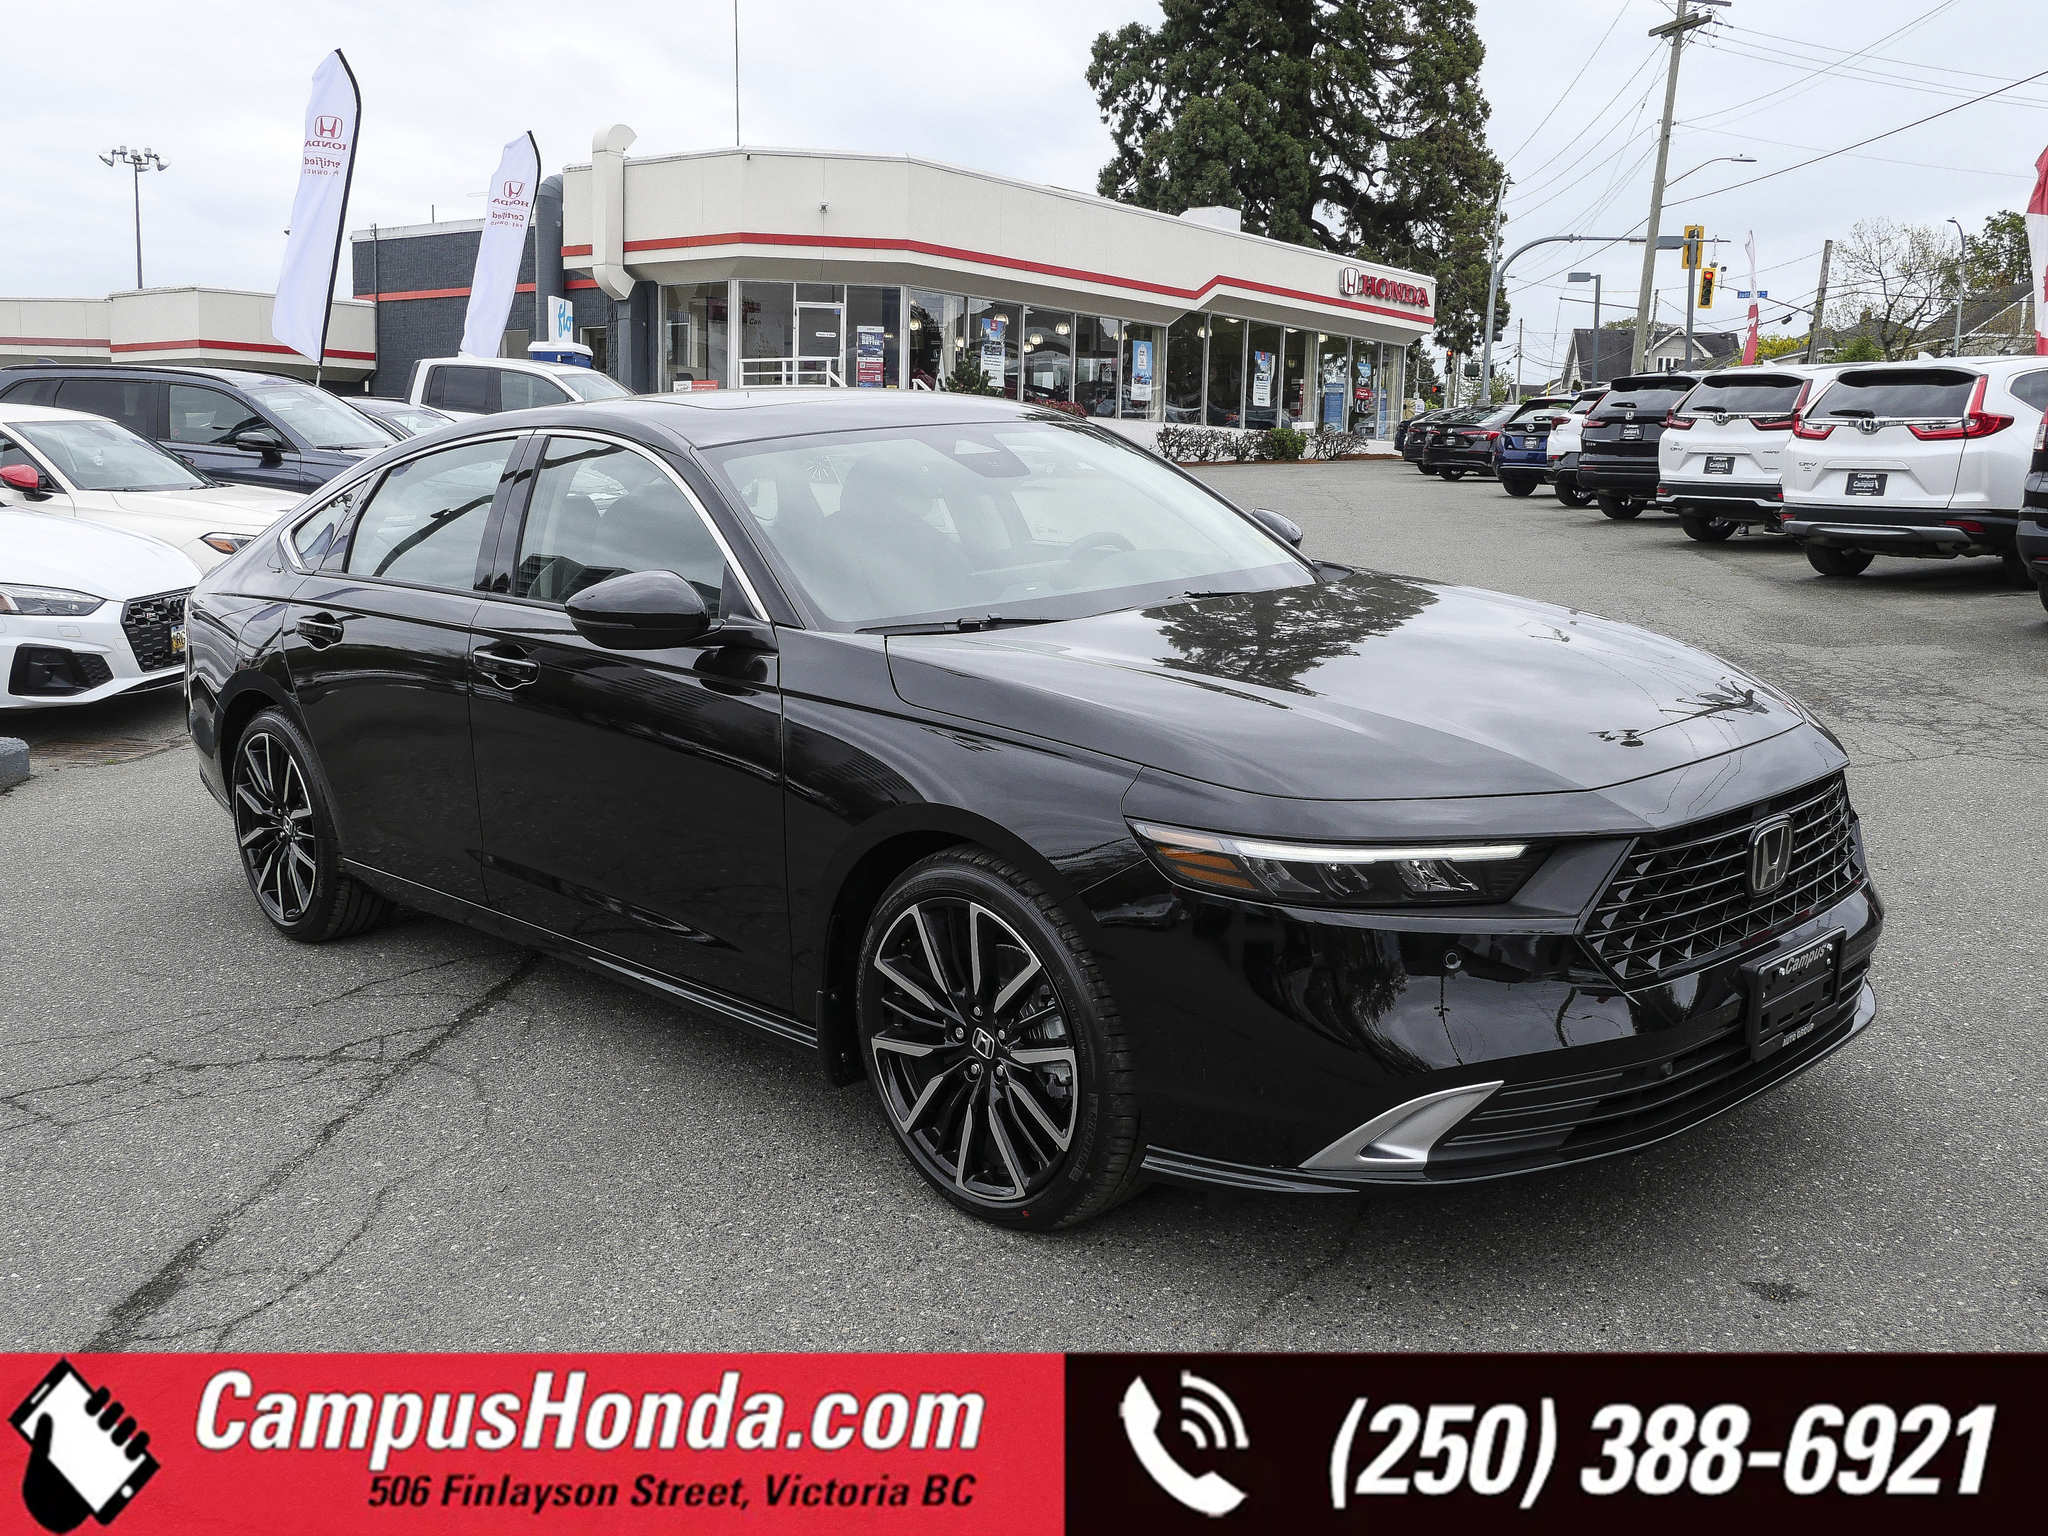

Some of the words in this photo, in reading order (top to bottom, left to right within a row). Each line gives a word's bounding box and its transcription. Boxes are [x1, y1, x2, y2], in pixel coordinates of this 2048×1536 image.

[1361, 275, 1430, 307] HONDA
[1785, 944, 1827, 975] Campus
[1796, 1022, 1815, 1039] GROUP
